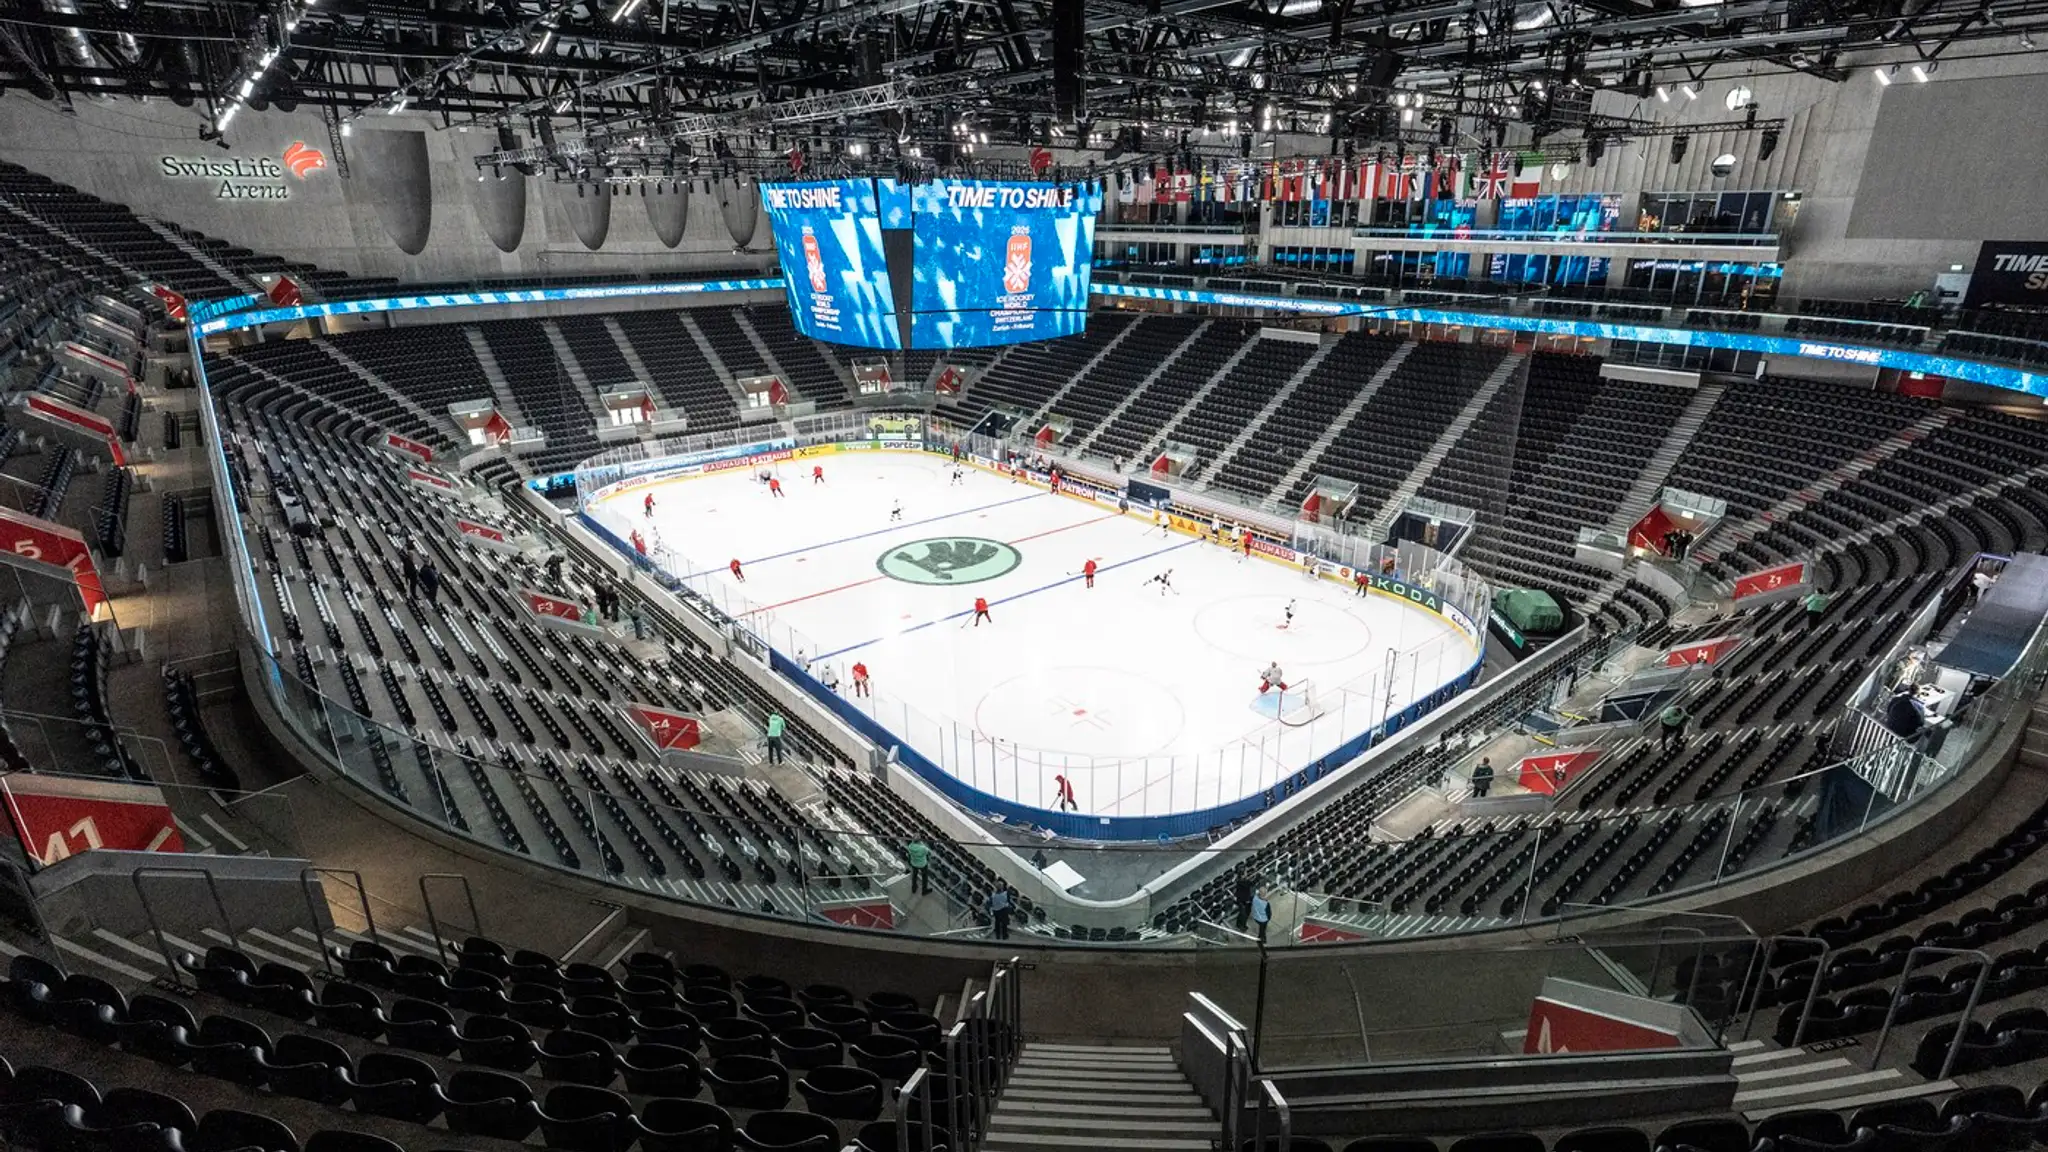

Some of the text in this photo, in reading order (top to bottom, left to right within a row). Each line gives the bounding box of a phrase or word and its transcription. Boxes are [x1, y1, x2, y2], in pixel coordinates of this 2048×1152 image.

[216, 180, 289, 199] Arena
[787, 188, 801, 208] TO
[802, 187, 841, 208] SHINE
[947, 186, 996, 207] TIME
[1000, 188, 1025, 208] TO
[1993, 254, 2048, 272] TIME
[1799, 343, 1829, 357] TIME
[1844, 348, 1881, 364] SHINE
[757, 450, 792, 465] STRAUSS
[1061, 482, 1094, 499] PATRON
[1250, 541, 1295, 561] AUHAUS
[537, 601, 554, 613] F3
